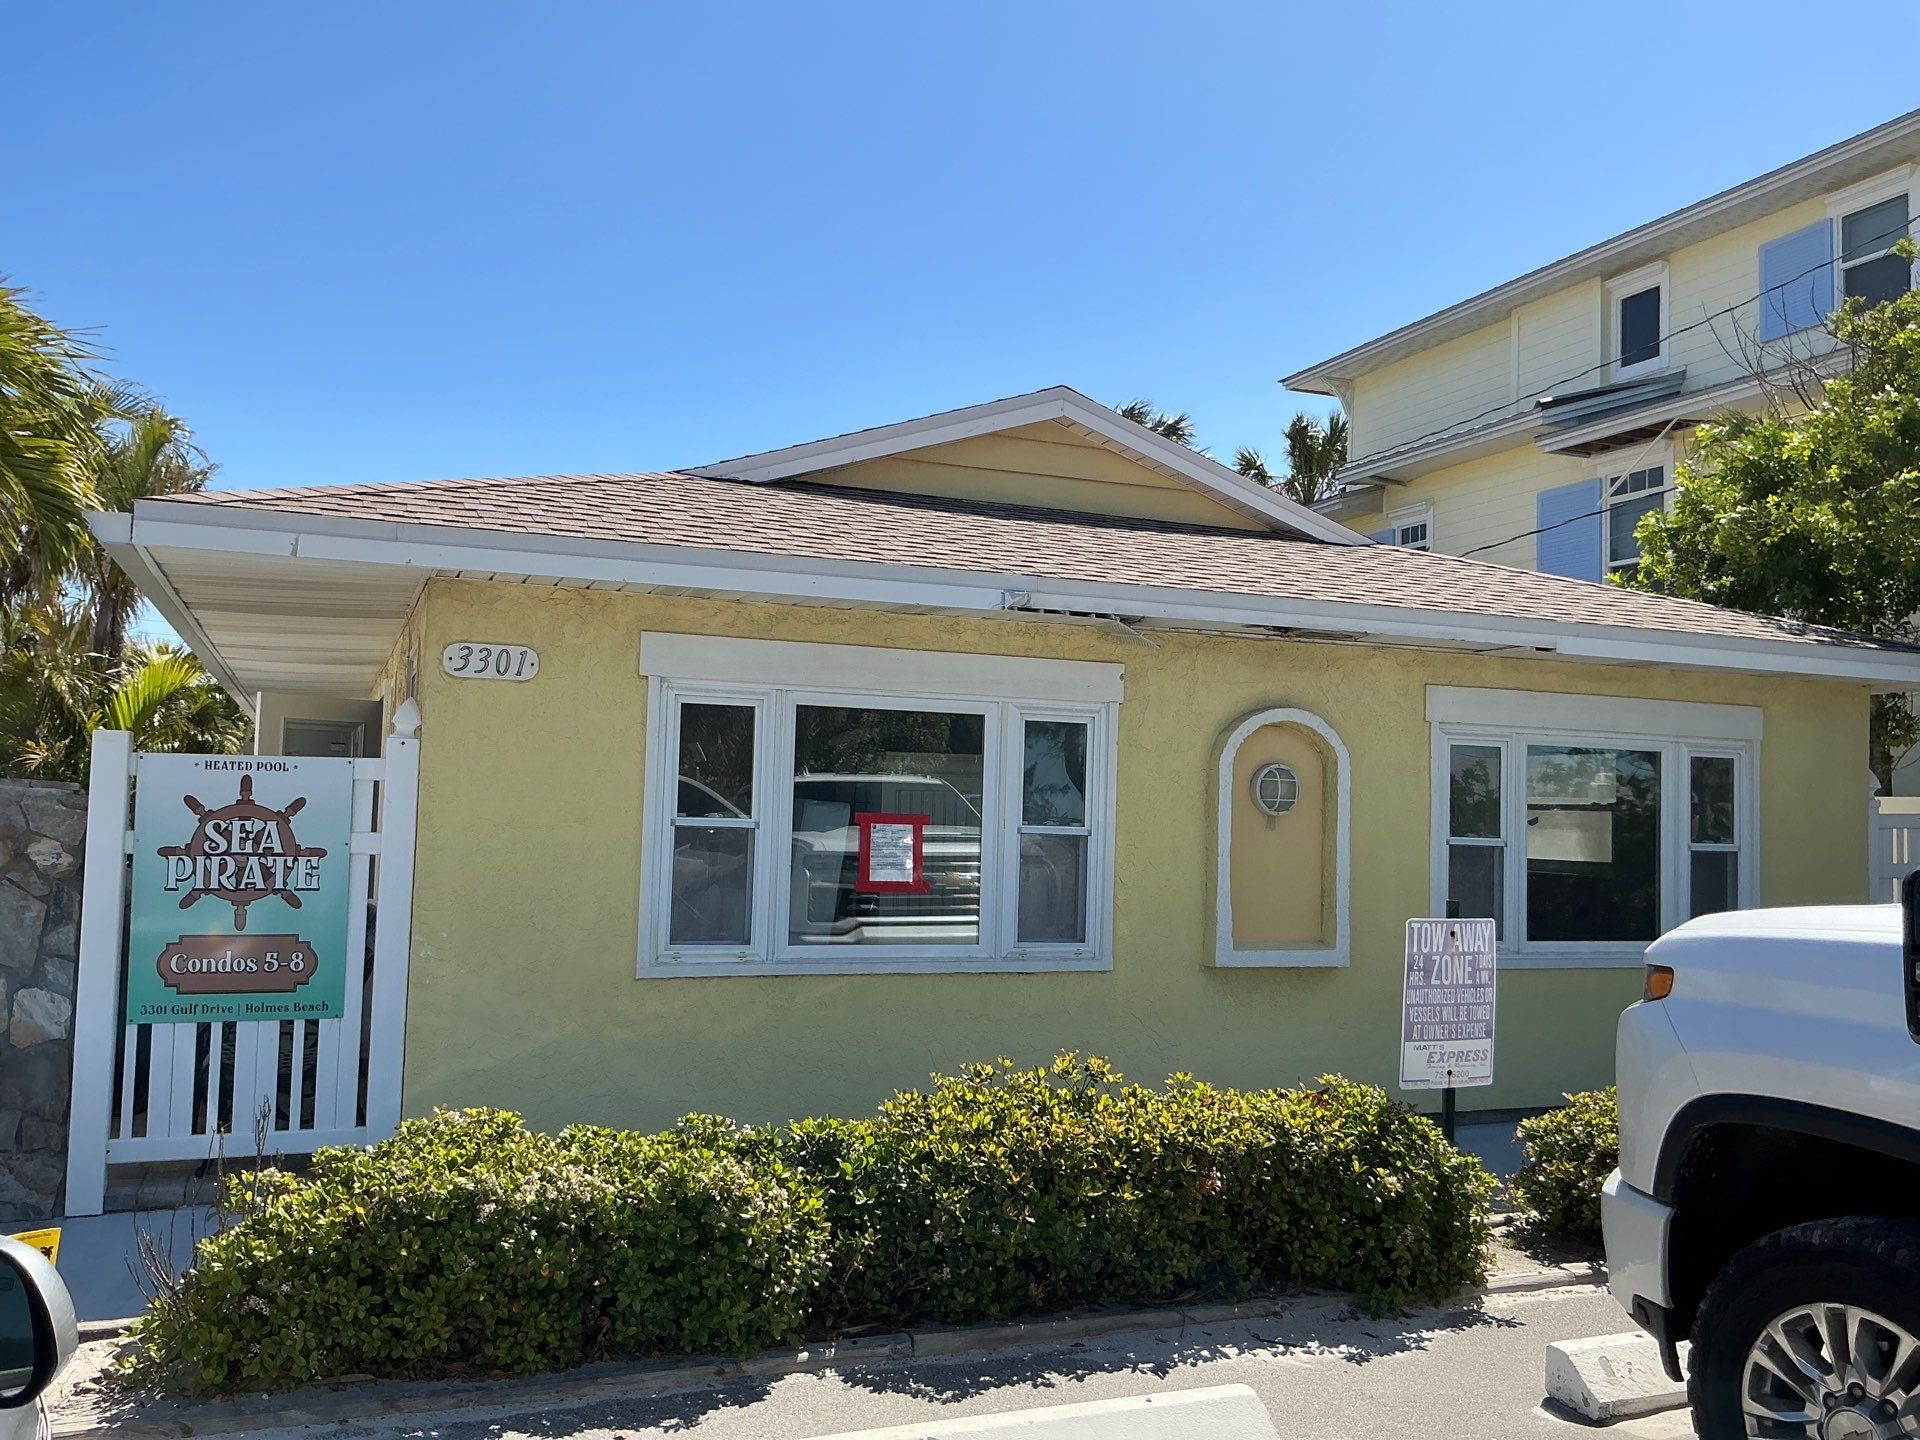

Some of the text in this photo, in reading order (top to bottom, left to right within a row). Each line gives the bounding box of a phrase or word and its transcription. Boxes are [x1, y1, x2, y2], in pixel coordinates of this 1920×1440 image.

[453, 645, 528, 676] 3301
[204, 760, 290, 772] HEATED POOL
[203, 818, 284, 856] SEA
[164, 854, 321, 892] PIRATE
[1411, 922, 1491, 953] TOW AWAY
[170, 950, 306, 974] Condos 5-8
[1413, 954, 1424, 970] 24
[1430, 954, 1473, 985] ZONE
[1409, 971, 1426, 986] HRS.
[1406, 987, 1493, 1004] UNAUTHORIZED VEHICLES OR
[140, 1000, 329, 1016] 3301 Gulf Drive Holmes Beach
[1409, 1004, 1490, 1022] VESSELS WILL BE TOWED
[1412, 1022, 1486, 1040] AT OWNER'S EXPENSE
[1426, 1048, 1489, 1064] EXPRESS
